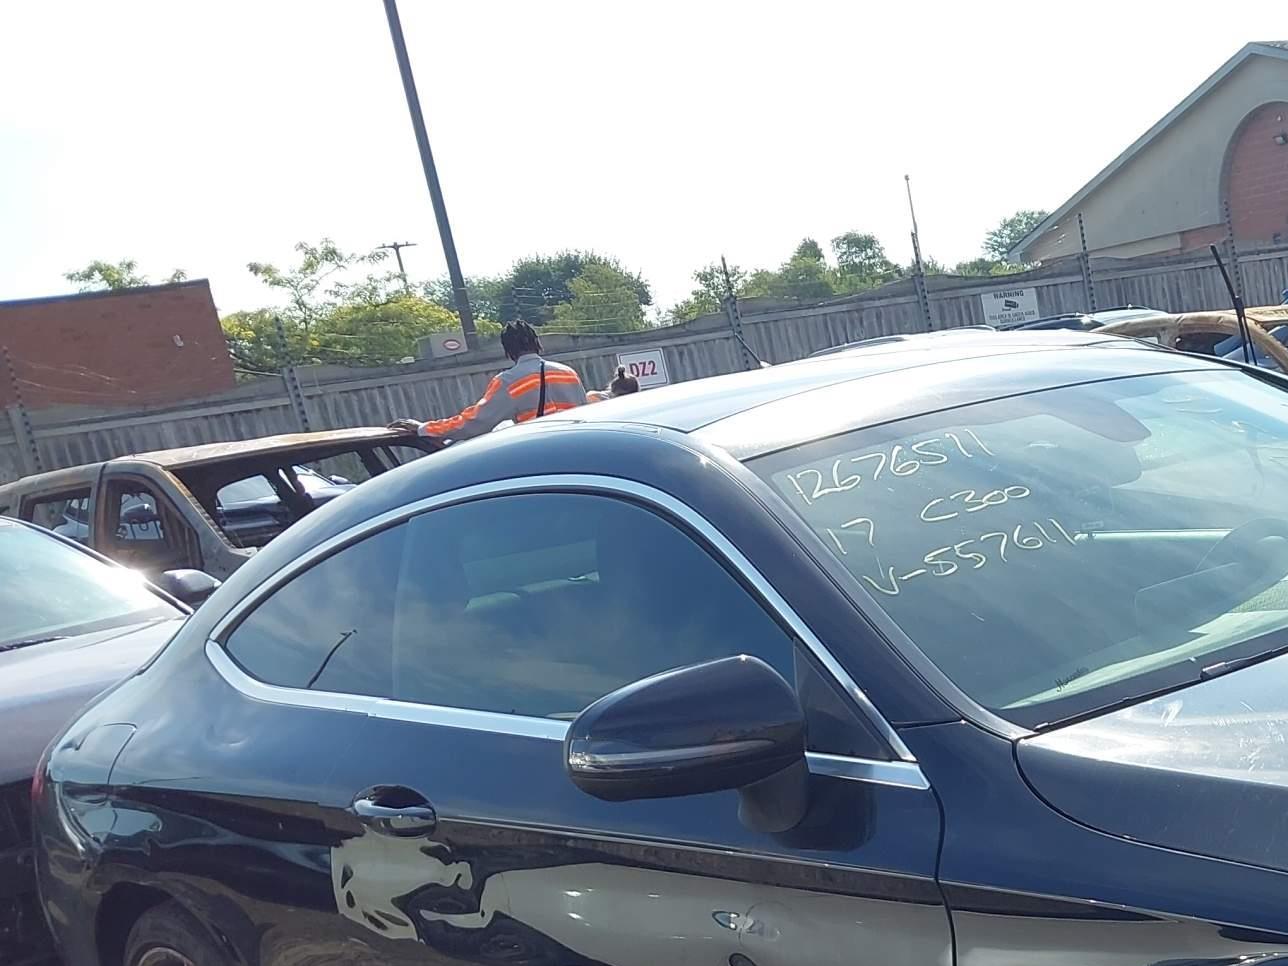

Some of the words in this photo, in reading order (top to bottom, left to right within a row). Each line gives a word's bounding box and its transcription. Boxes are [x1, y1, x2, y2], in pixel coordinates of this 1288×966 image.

[628, 360, 658, 378] DZ2
[787, 428, 995, 504] 12676511
[826, 518, 875, 555] 17
[920, 486, 1031, 522] C300
